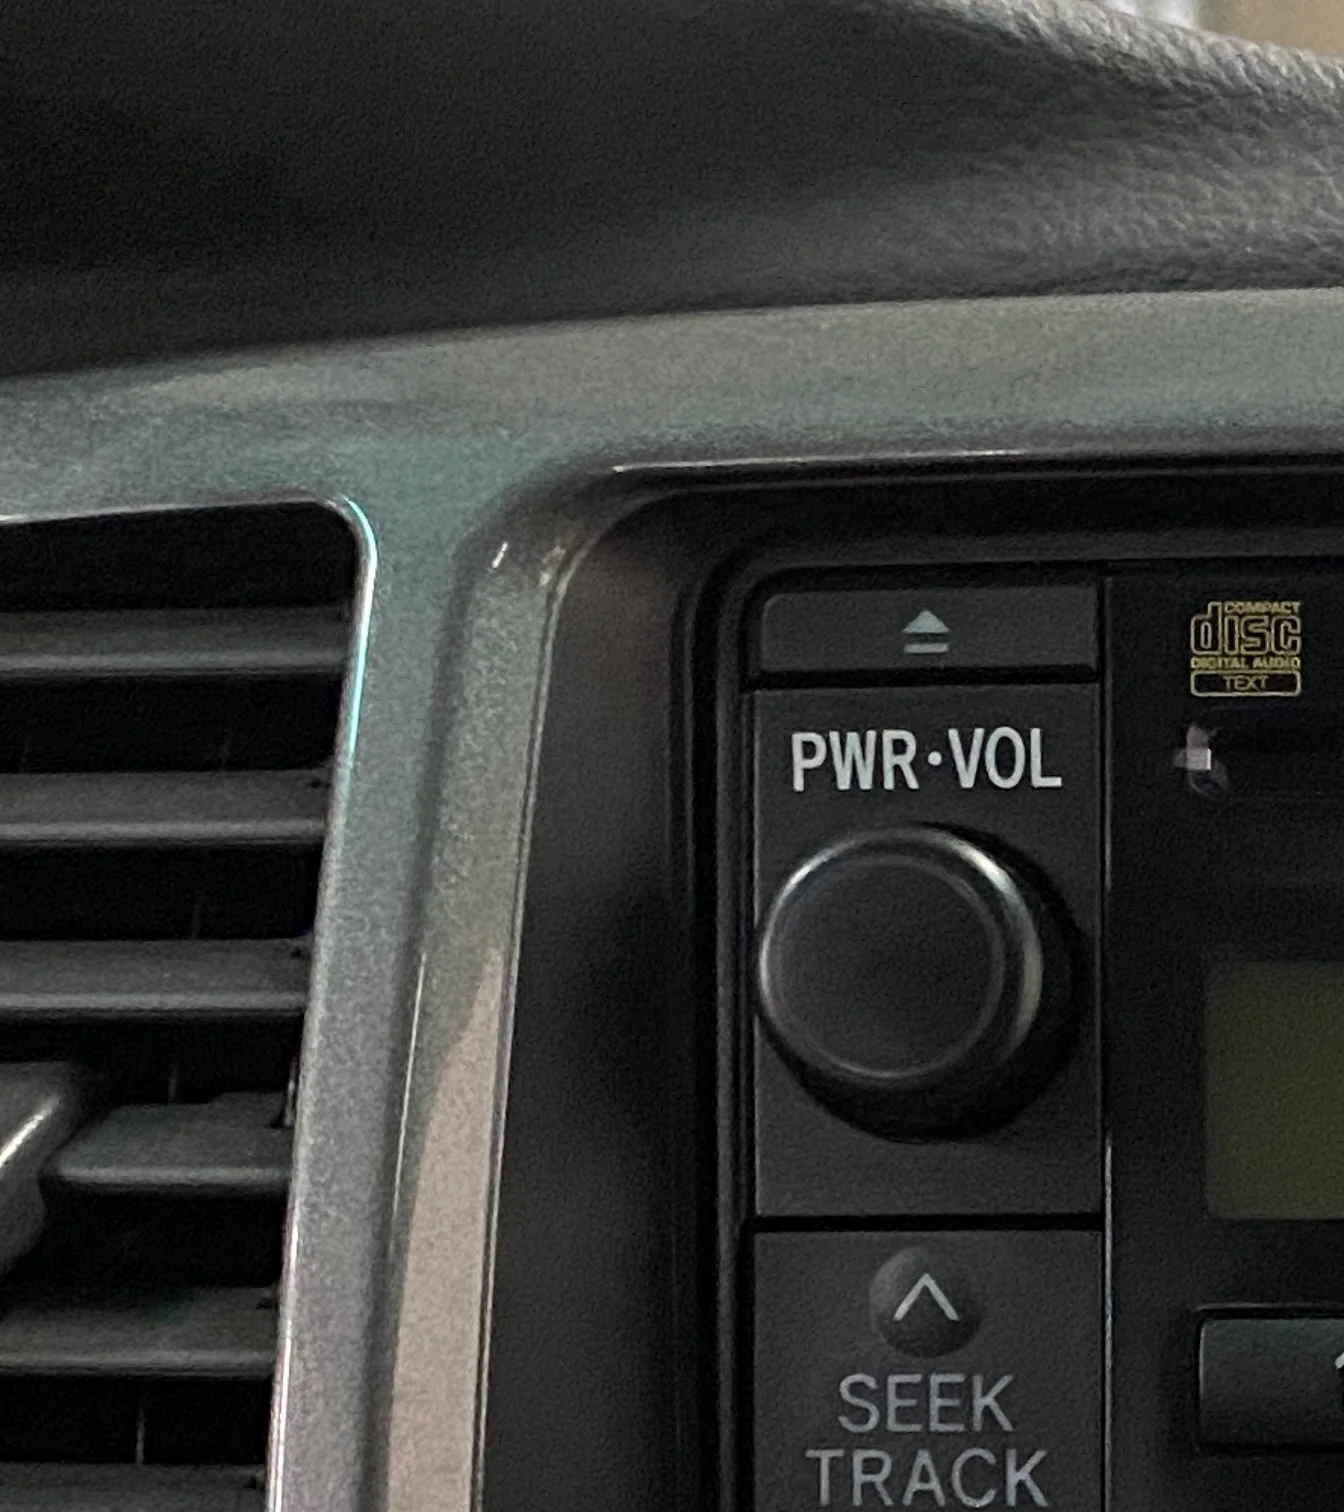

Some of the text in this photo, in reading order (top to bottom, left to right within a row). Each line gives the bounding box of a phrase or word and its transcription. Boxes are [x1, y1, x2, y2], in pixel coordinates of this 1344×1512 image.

[1224, 601, 1300, 613] COMPACT
[1190, 656, 1301, 669] DIGITAL AUDIO
[1223, 675, 1268, 691] TEXT
[837, 1373, 1016, 1434] SEEK
[806, 1448, 1050, 1508] TRACK
